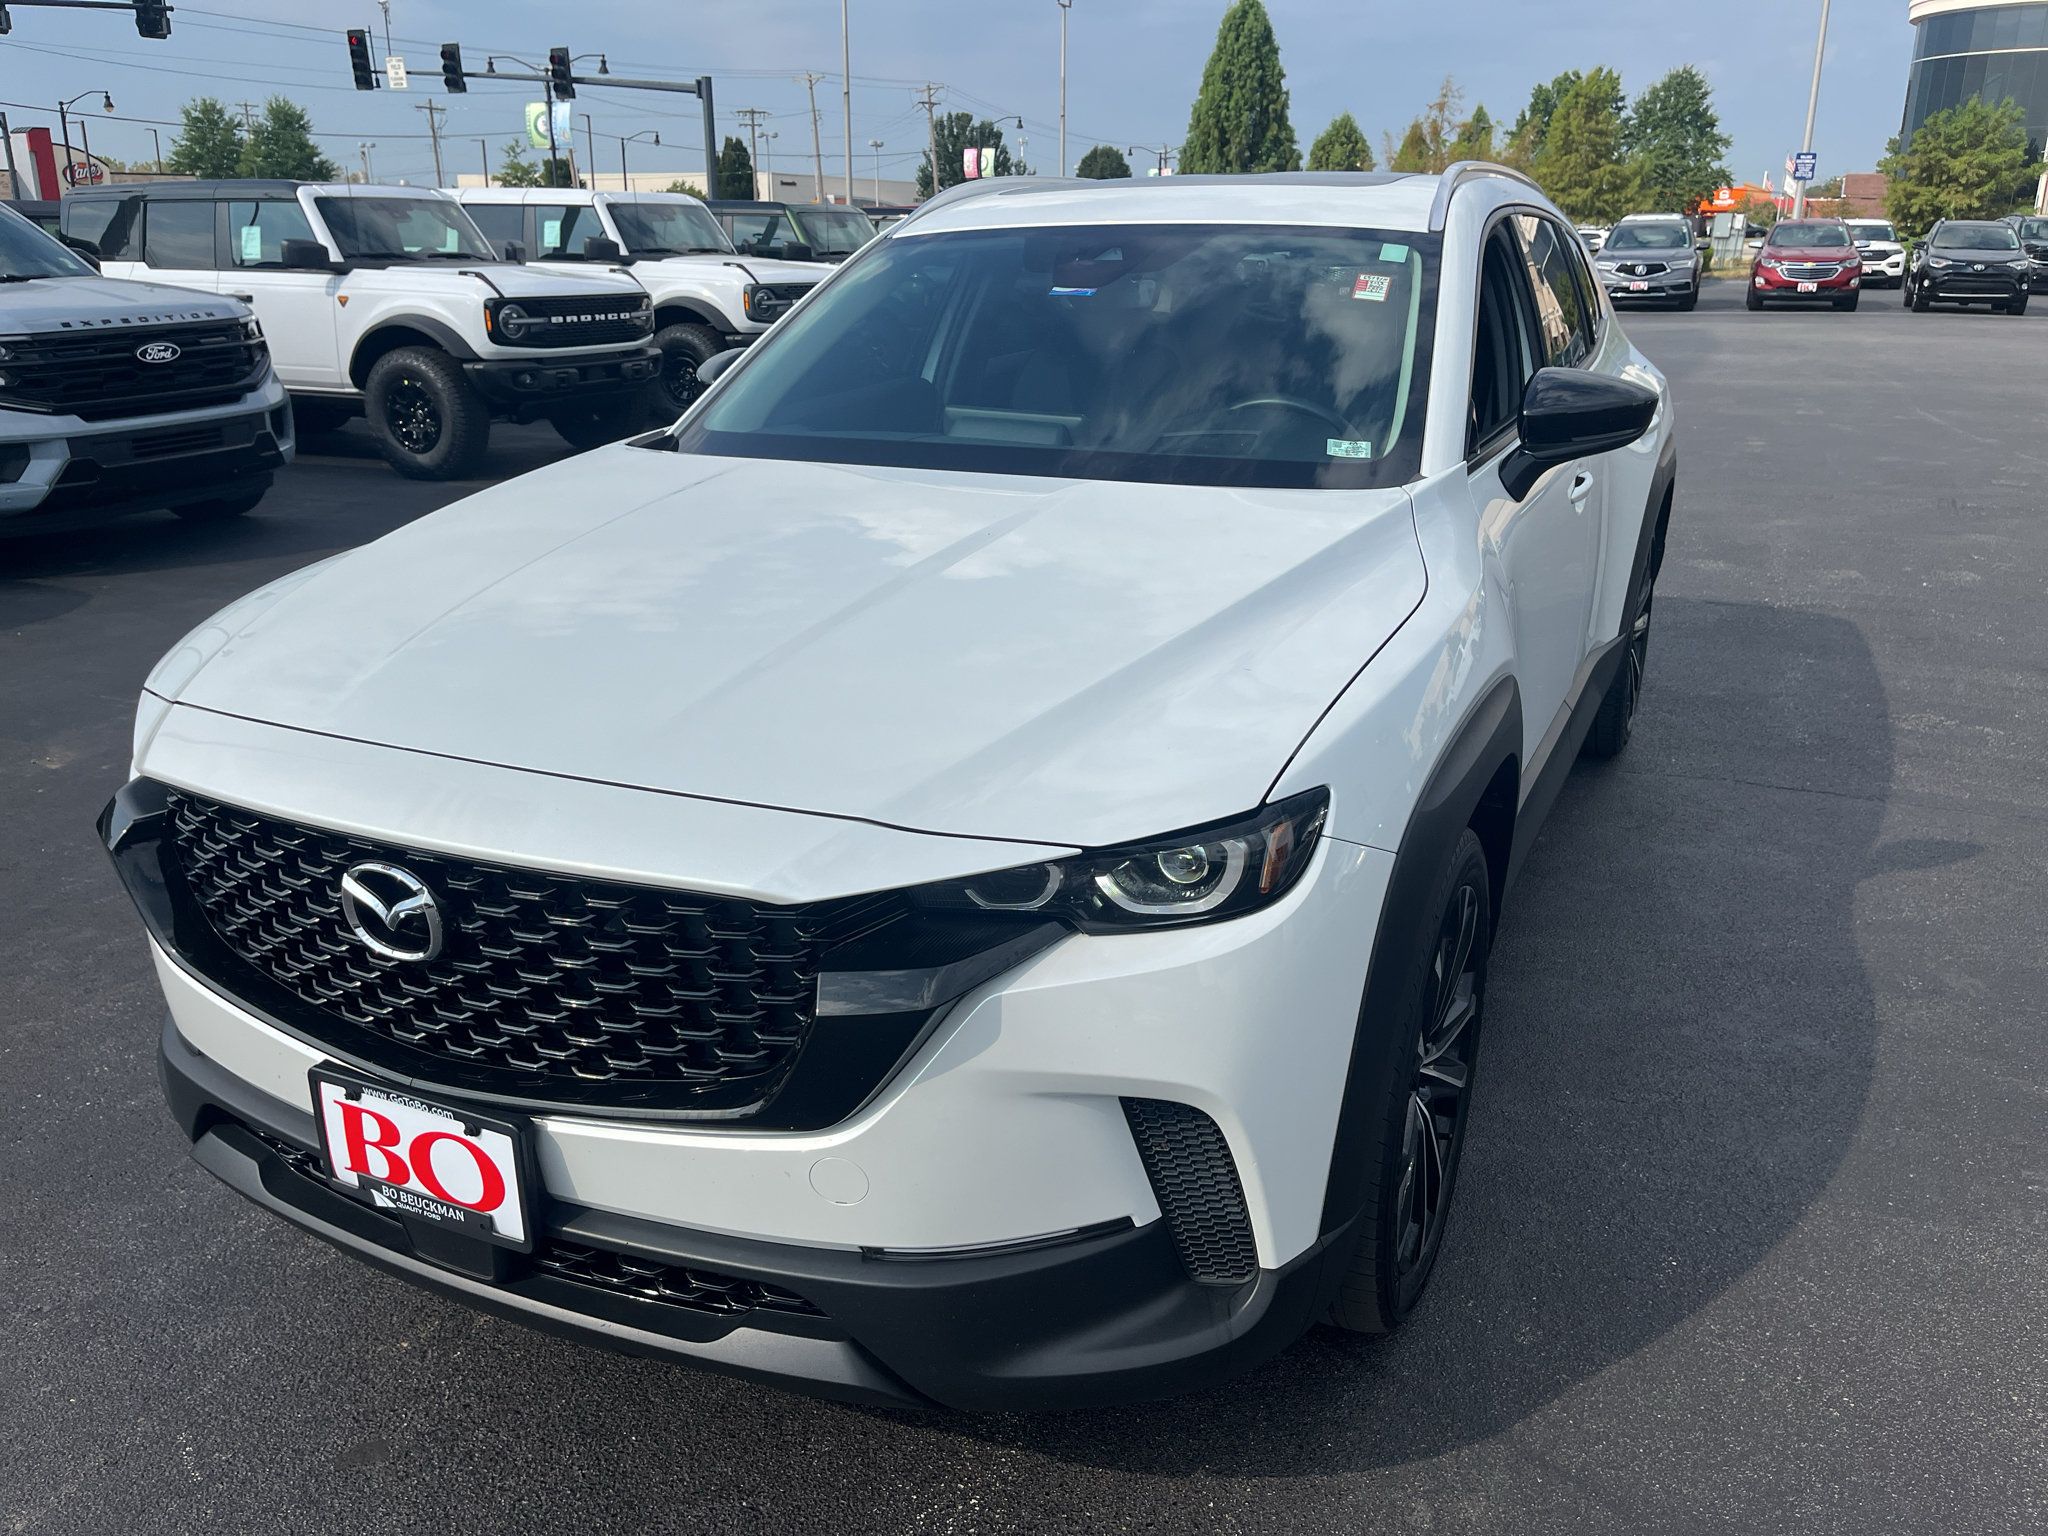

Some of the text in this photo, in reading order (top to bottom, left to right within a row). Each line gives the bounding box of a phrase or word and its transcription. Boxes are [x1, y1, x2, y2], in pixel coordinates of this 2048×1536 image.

[61, 312, 215, 328] EXPEDITION
[551, 312, 630, 323] BRONCO
[146, 346, 172, 360] Ford
[362, 1086, 454, 1120] www.GoToBo.com
[333, 1099, 506, 1213] BO
[382, 1185, 464, 1222] BO BEUCKMAN
[396, 1201, 441, 1221] QUALITY FORD
